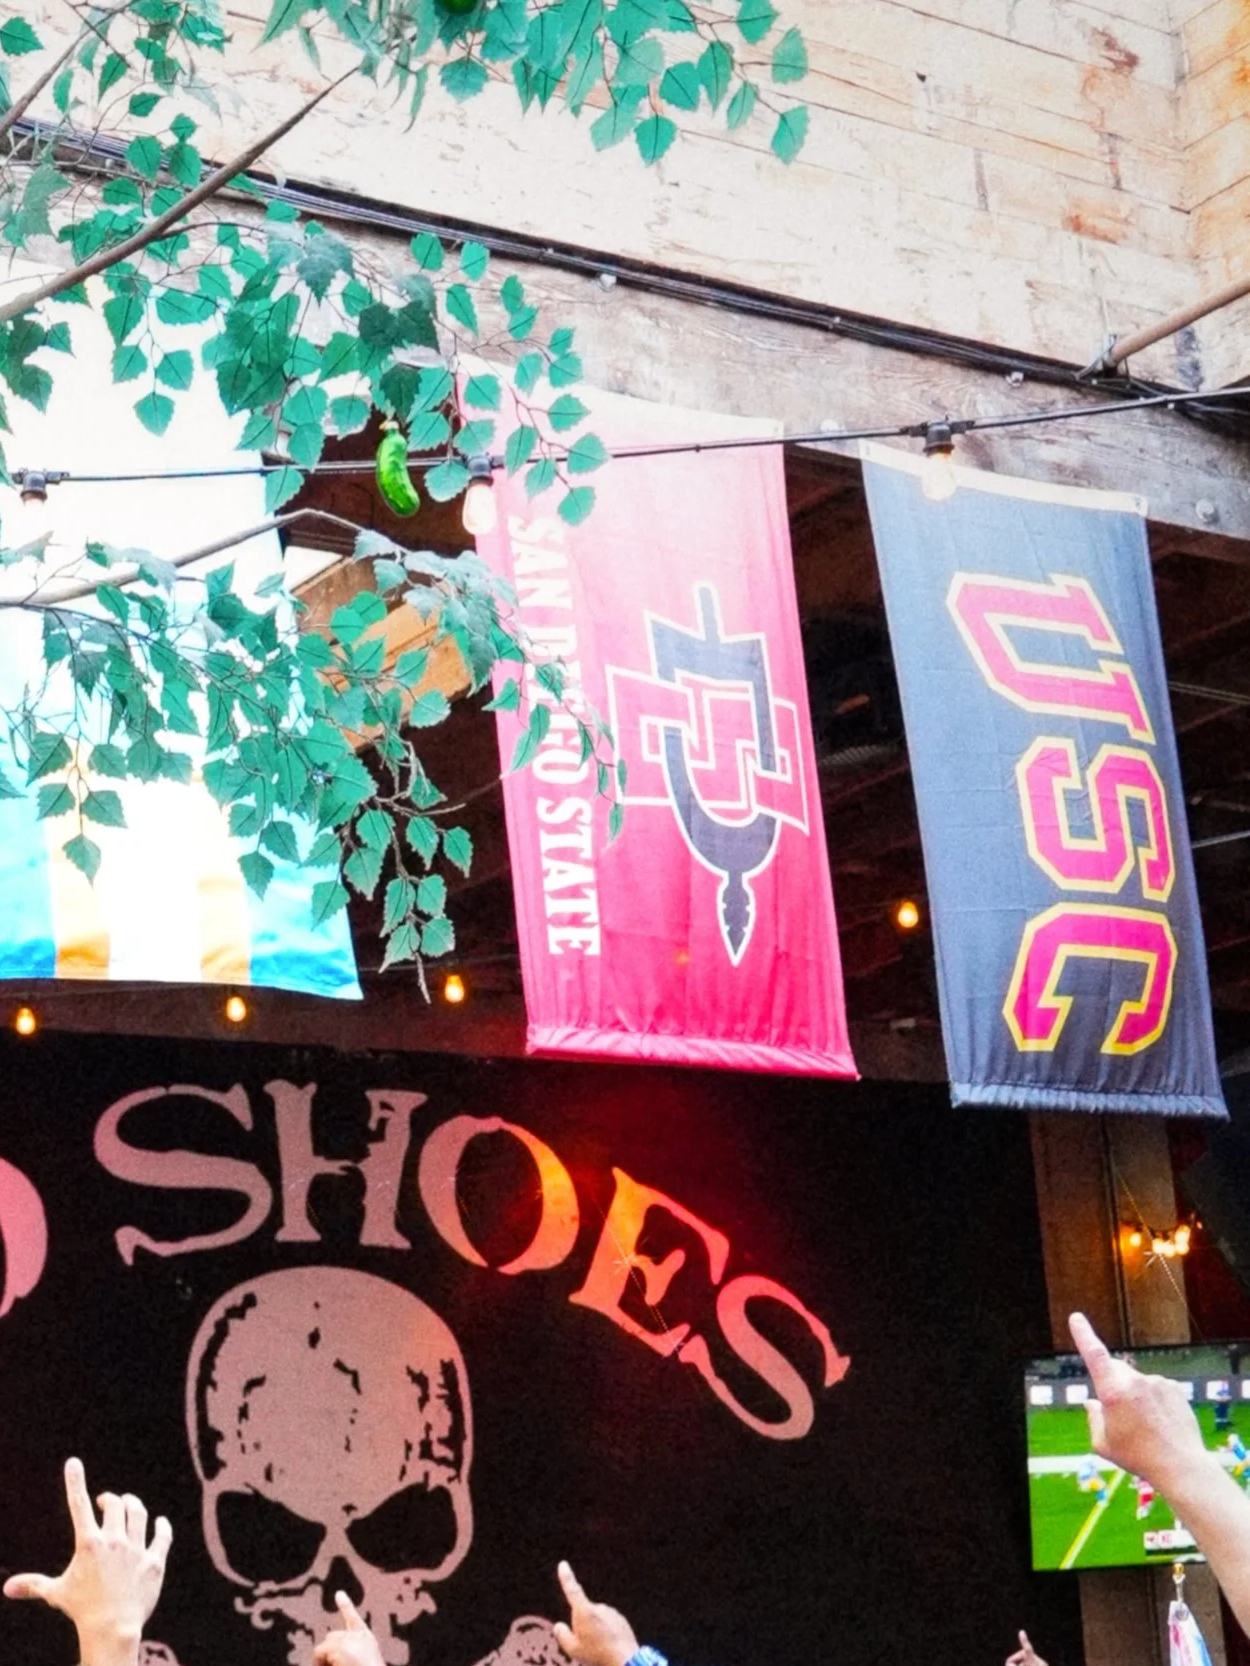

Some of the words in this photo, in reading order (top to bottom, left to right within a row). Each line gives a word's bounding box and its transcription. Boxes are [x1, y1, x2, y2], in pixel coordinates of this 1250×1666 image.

[508, 515, 574, 611] SAN
[537, 797, 602, 957] STATE
[946, 571, 1178, 1056] USC
[93, 1079, 852, 1440] SHOES
